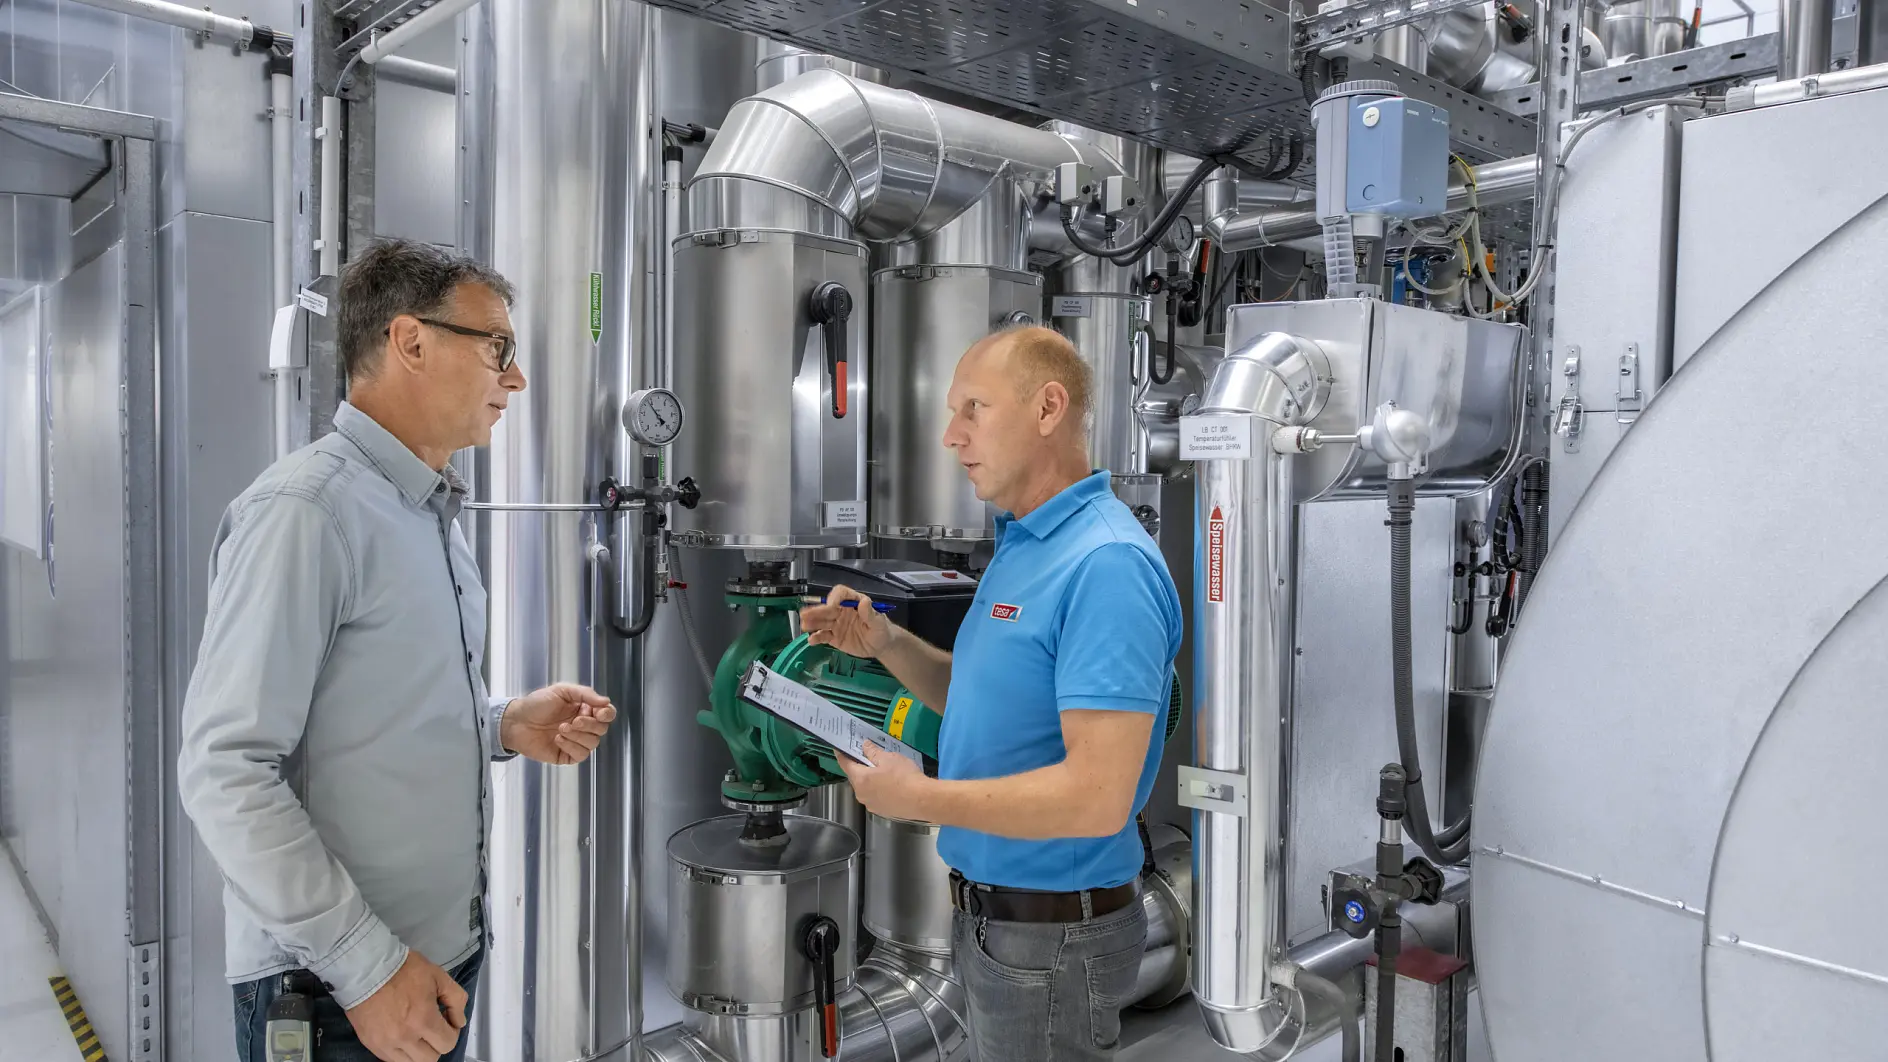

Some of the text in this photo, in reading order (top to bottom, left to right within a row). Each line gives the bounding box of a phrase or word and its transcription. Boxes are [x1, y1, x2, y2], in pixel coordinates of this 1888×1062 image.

[1201, 426, 1209, 434] LB
[1188, 444, 1223, 452] Speisewasser
[1210, 523, 1223, 600] Speisewasser
[994, 606, 1009, 617] tesa
